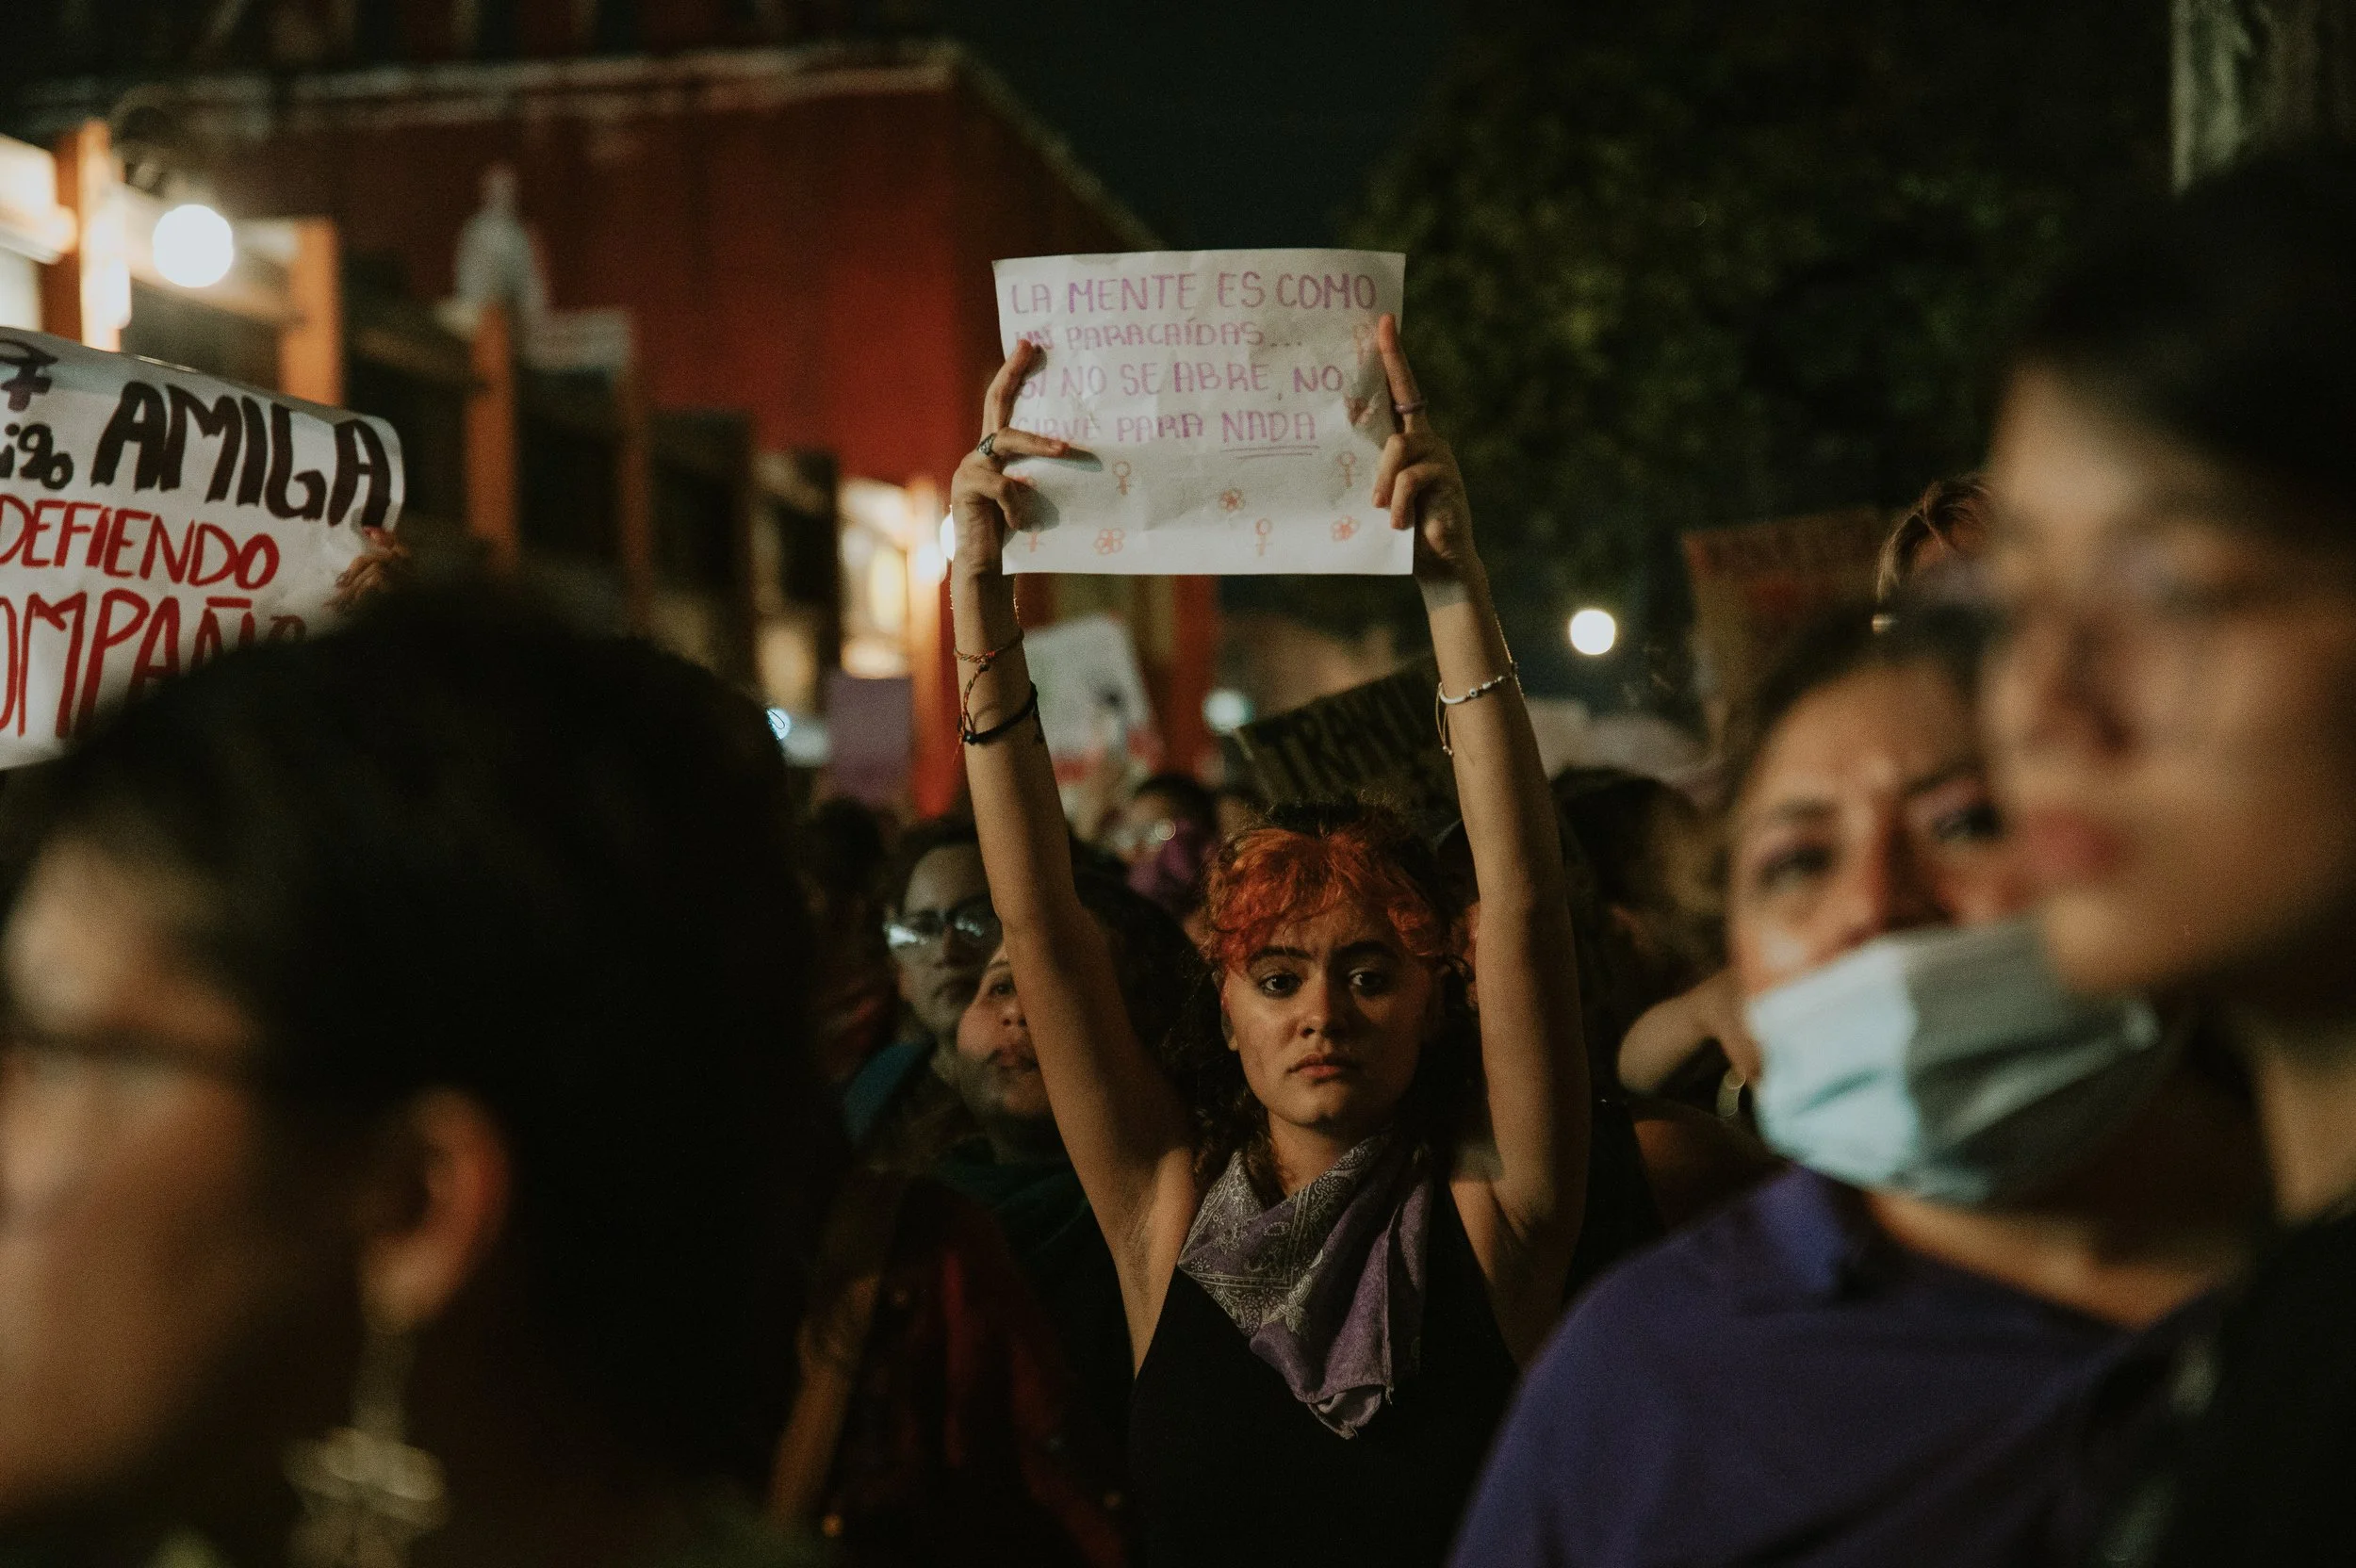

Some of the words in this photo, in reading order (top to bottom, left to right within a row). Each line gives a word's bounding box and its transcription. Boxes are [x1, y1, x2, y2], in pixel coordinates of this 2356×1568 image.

[1012, 283, 1053, 314] LA
[1068, 273, 1197, 314] MENTE
[1217, 270, 1266, 308] ES
[1275, 272, 1377, 310] COMO
[1060, 365, 1107, 398] NO
[1119, 362, 1161, 396] SE
[1293, 365, 1344, 394] NO
[1116, 412, 1203, 443] PARA
[1220, 410, 1317, 444] NADA
[90, 380, 392, 528] AMIGA
[0, 493, 280, 590] DEFIENDO
